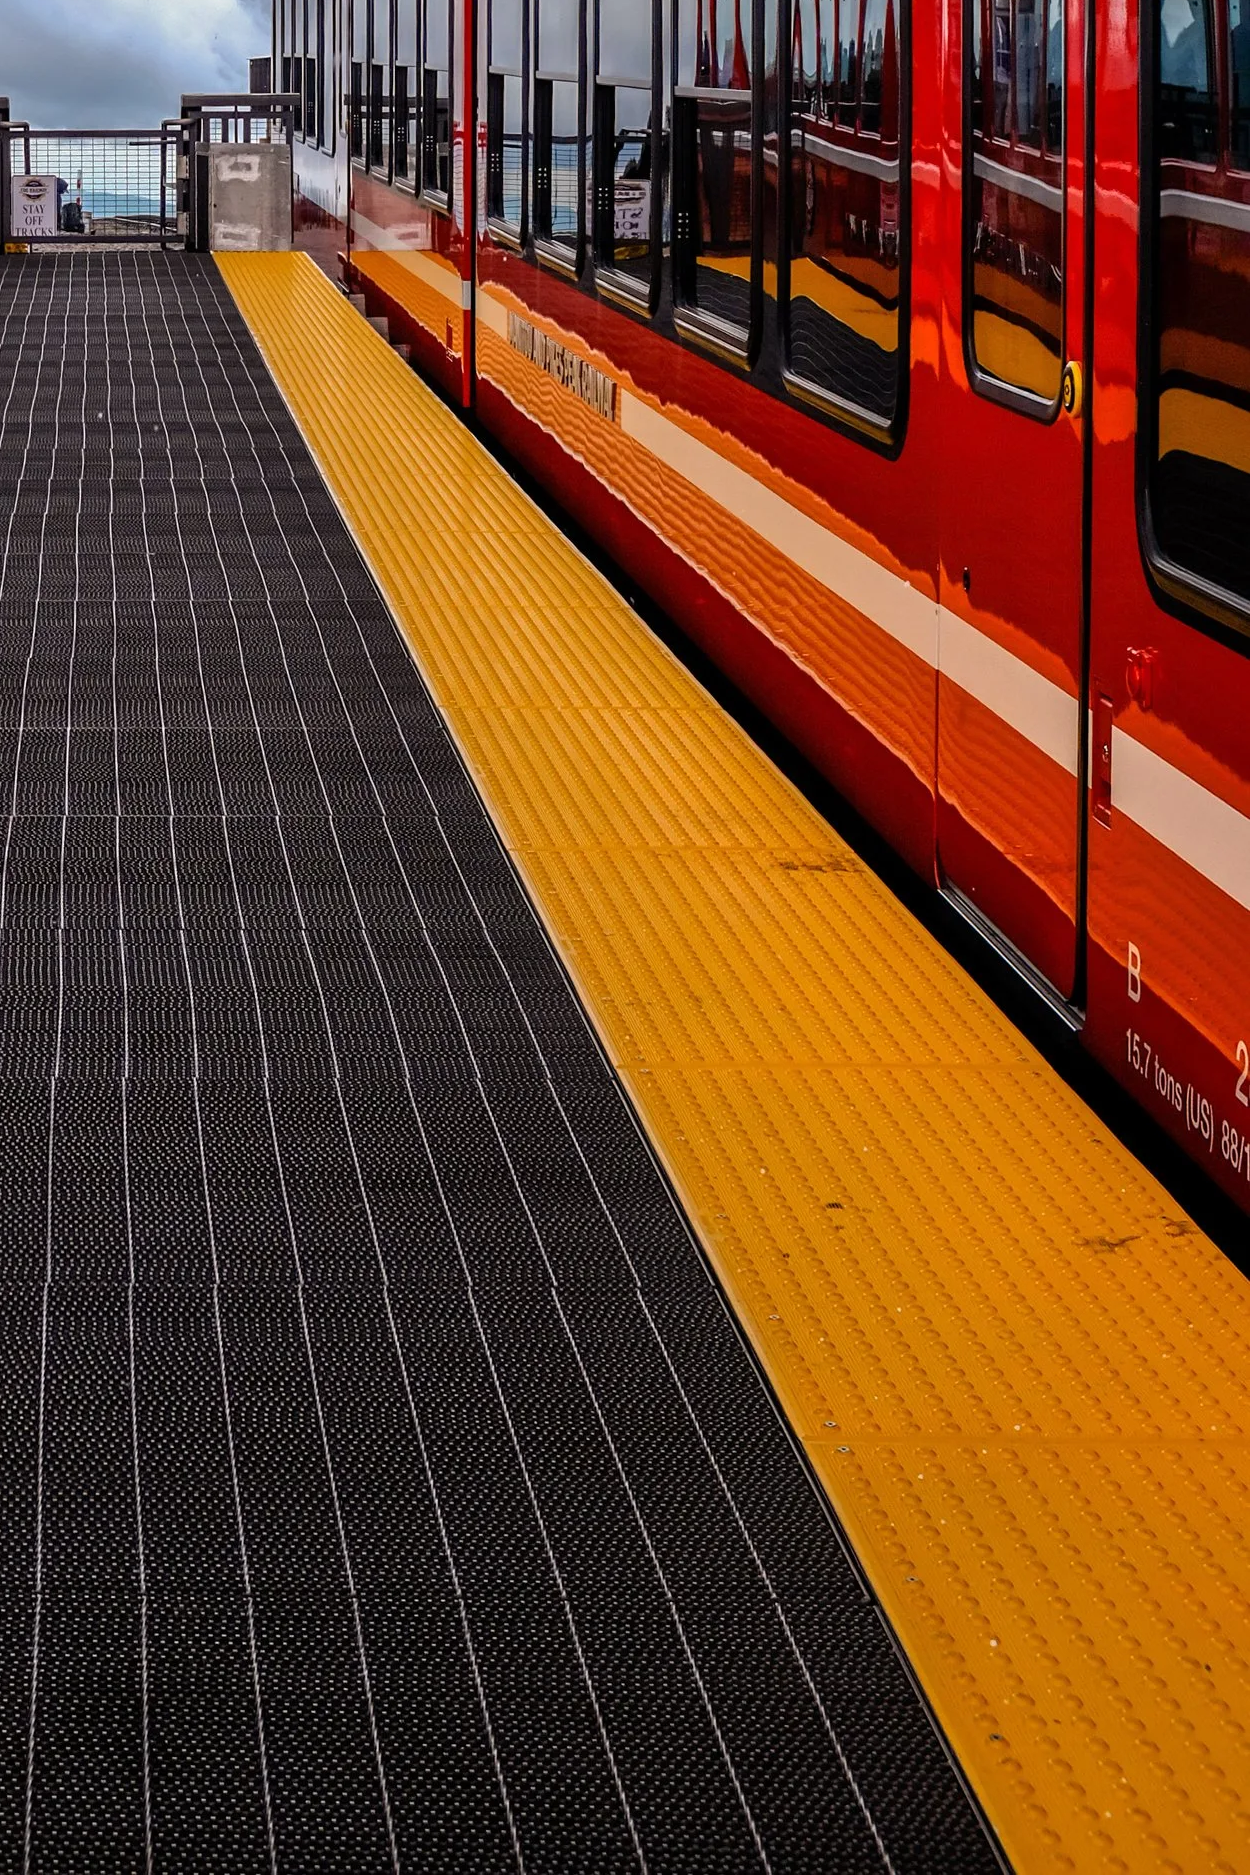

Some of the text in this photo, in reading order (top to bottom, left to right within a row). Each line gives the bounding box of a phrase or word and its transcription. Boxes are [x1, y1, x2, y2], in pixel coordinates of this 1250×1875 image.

[23, 205, 45, 214] STAY
[25, 216, 43, 225] OFF
[16, 228, 53, 236] TRACKS
[1128, 940, 1141, 1003] B
[1126, 1028, 1151, 1079] 15.7
[1154, 1054, 1183, 1111] tons
[1186, 1083, 1214, 1153] (US)
[1235, 1040, 1250, 1107] 2
